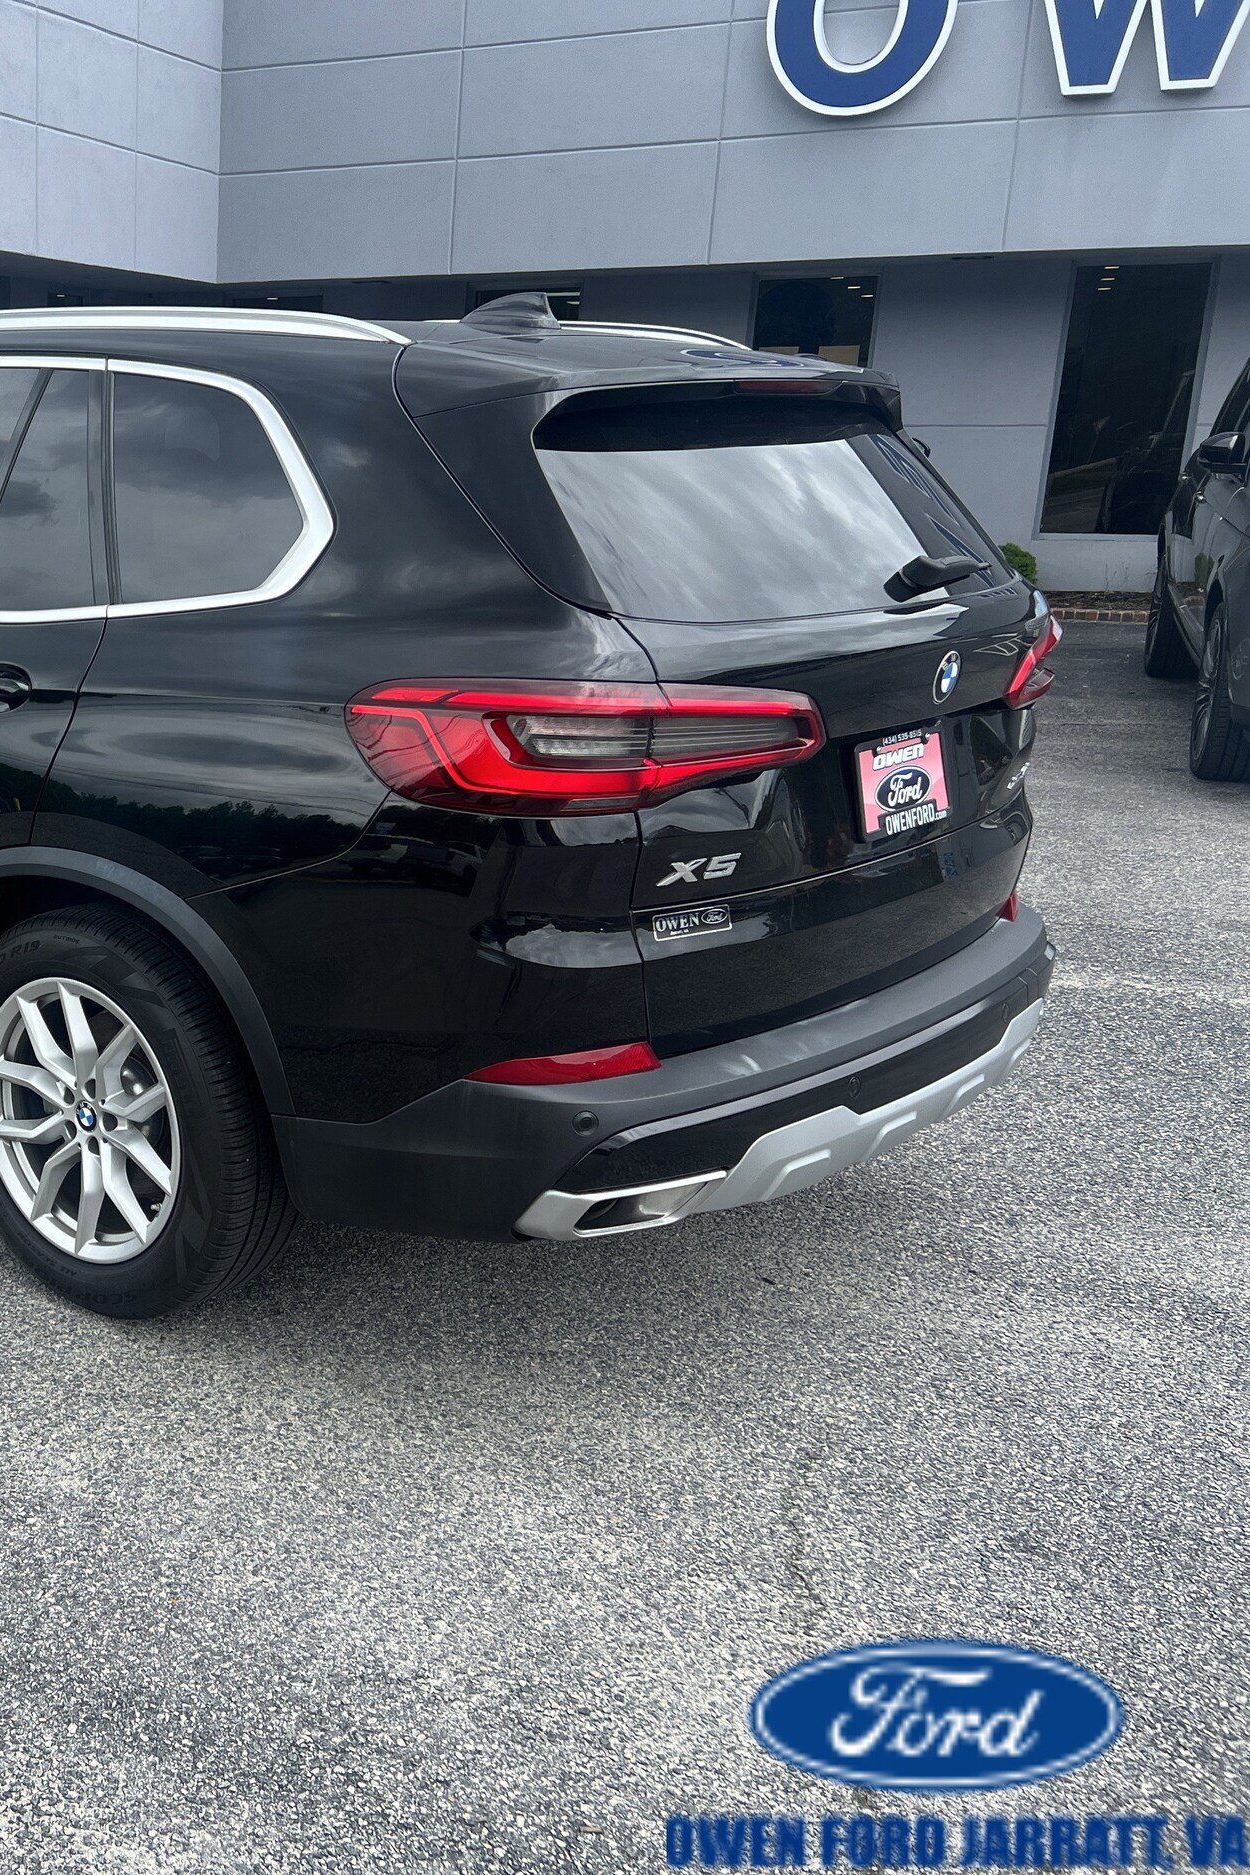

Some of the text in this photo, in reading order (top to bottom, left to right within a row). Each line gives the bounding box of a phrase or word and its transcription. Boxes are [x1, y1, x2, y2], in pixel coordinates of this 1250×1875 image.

[887, 772, 923, 807] Ford
[885, 803, 947, 835] OWENFORD.com
[655, 852, 742, 887] X5
[655, 912, 700, 932] OWEN
